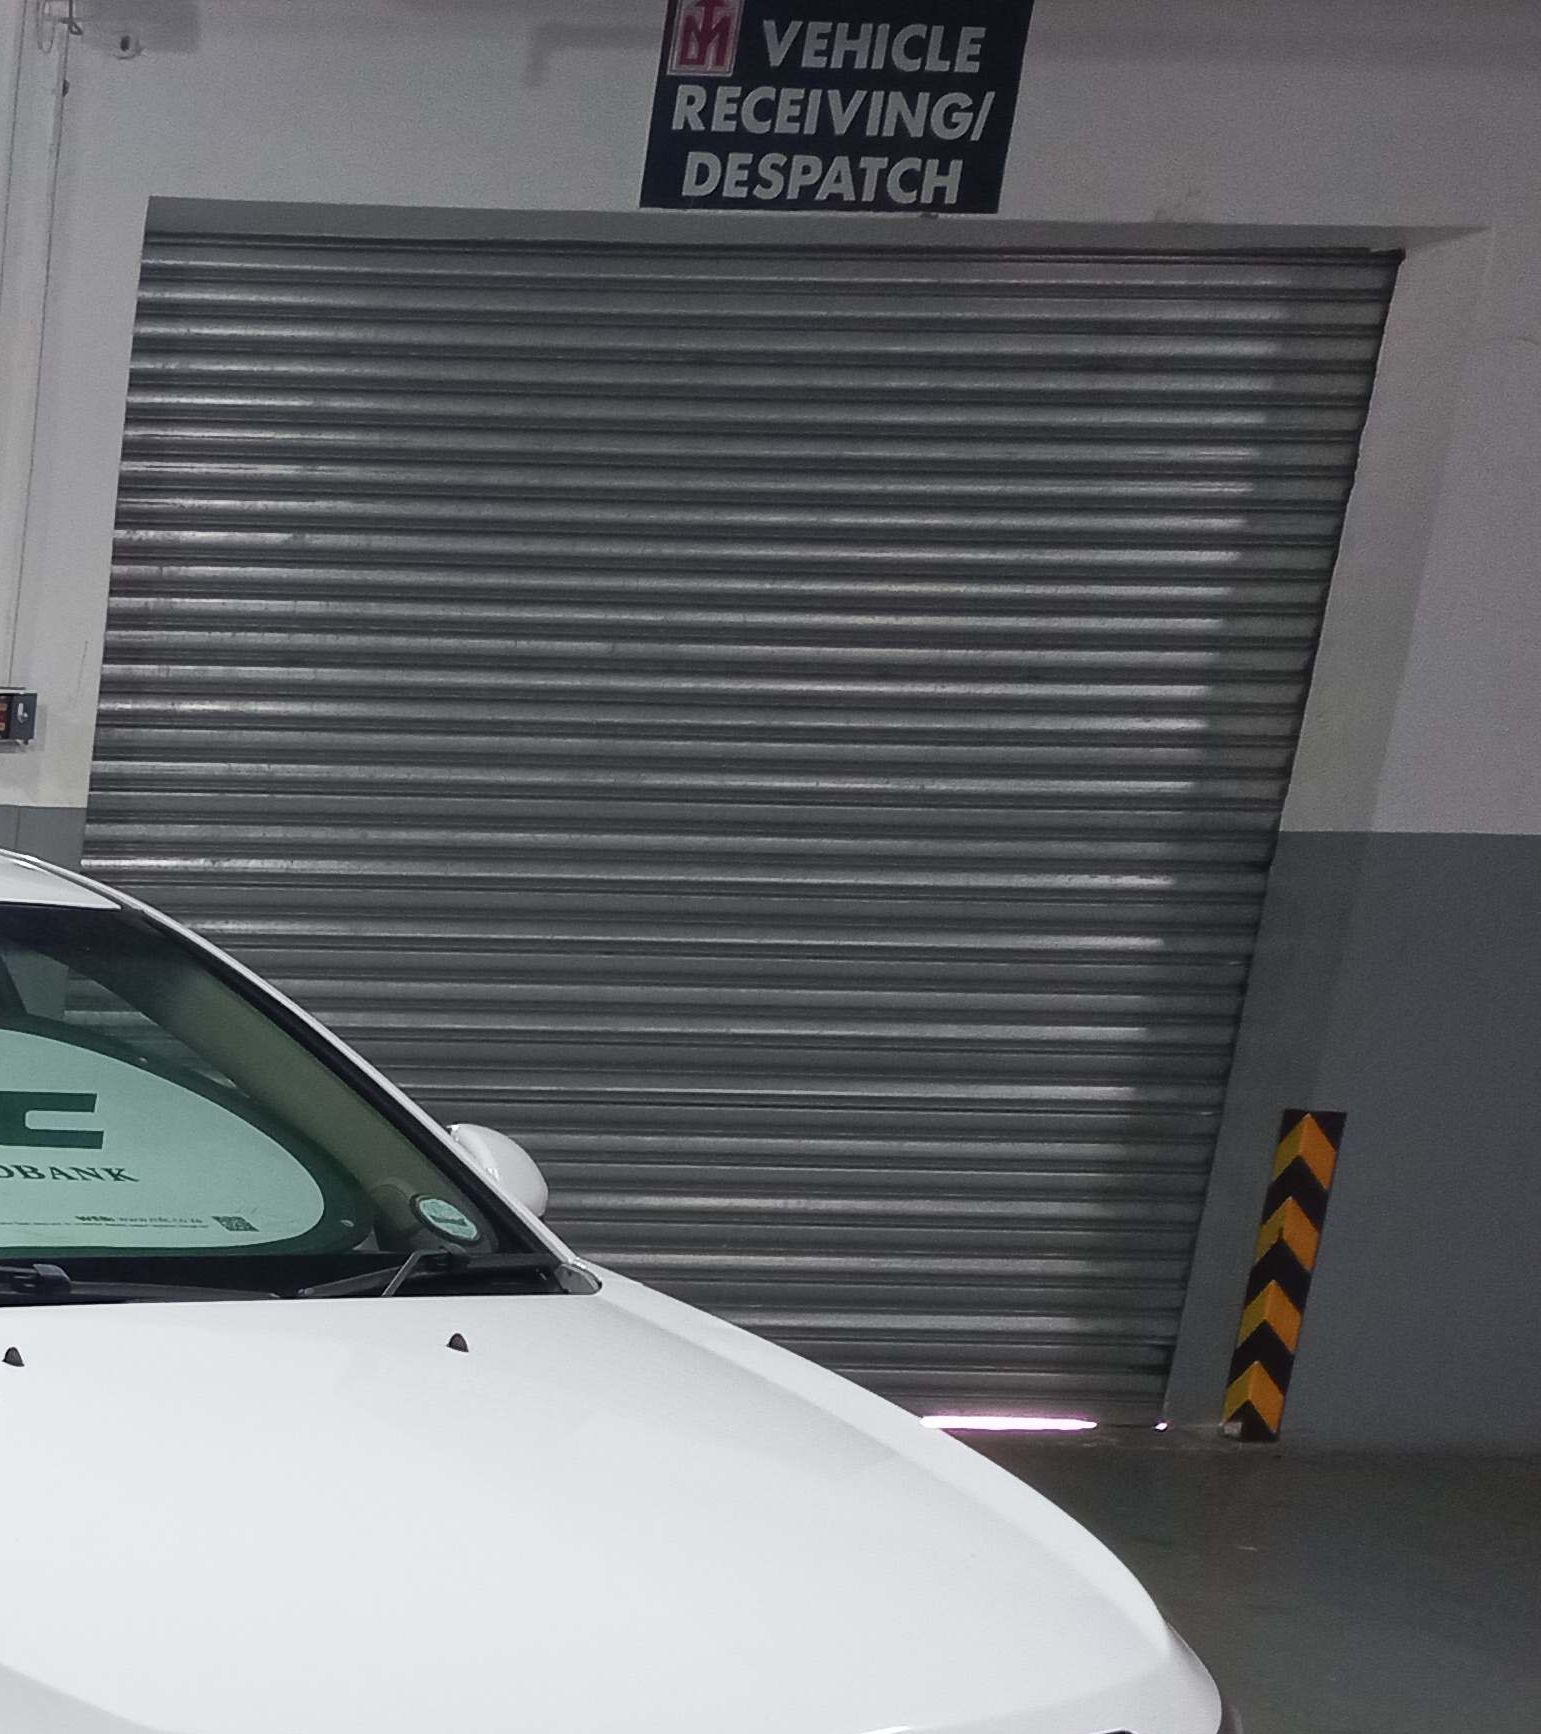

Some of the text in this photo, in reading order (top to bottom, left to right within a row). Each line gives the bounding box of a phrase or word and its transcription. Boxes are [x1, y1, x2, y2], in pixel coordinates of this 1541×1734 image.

[763, 19, 987, 73] VEHICLE
[671, 84, 996, 142] RECEIVING/
[681, 151, 964, 205] DESPATCH
